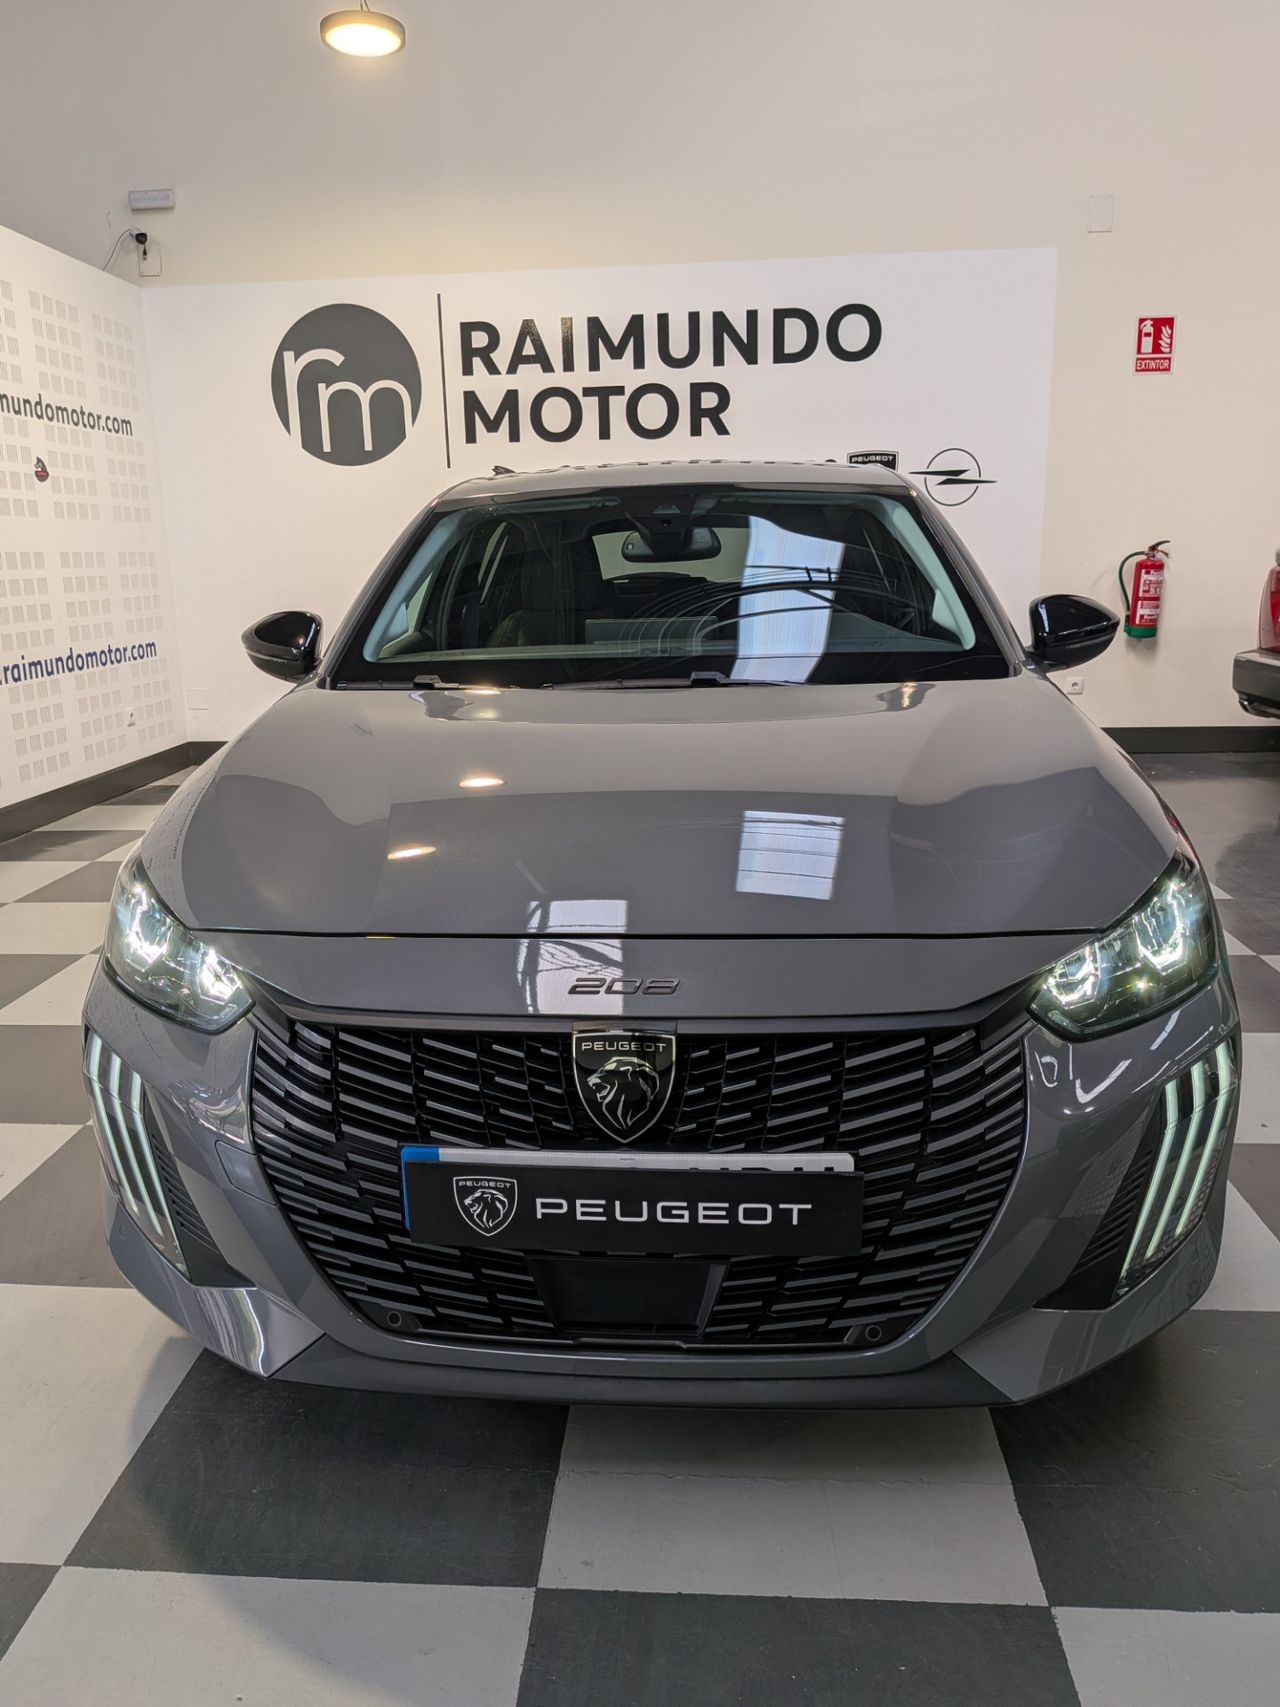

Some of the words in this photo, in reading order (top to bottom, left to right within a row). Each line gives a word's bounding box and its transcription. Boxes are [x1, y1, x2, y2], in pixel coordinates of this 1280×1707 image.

[459, 303, 883, 377] RAIMUNDO
[1136, 359, 1170, 370] EXTINTOR
[463, 381, 732, 445] MOTOR
[851, 455, 894, 463] PEUGEOT
[568, 977, 681, 996] 208
[581, 1041, 667, 1052] PEUGEOT
[458, 1180, 512, 1189] PEUGEOT
[535, 1197, 813, 1226] PEUGEOT
